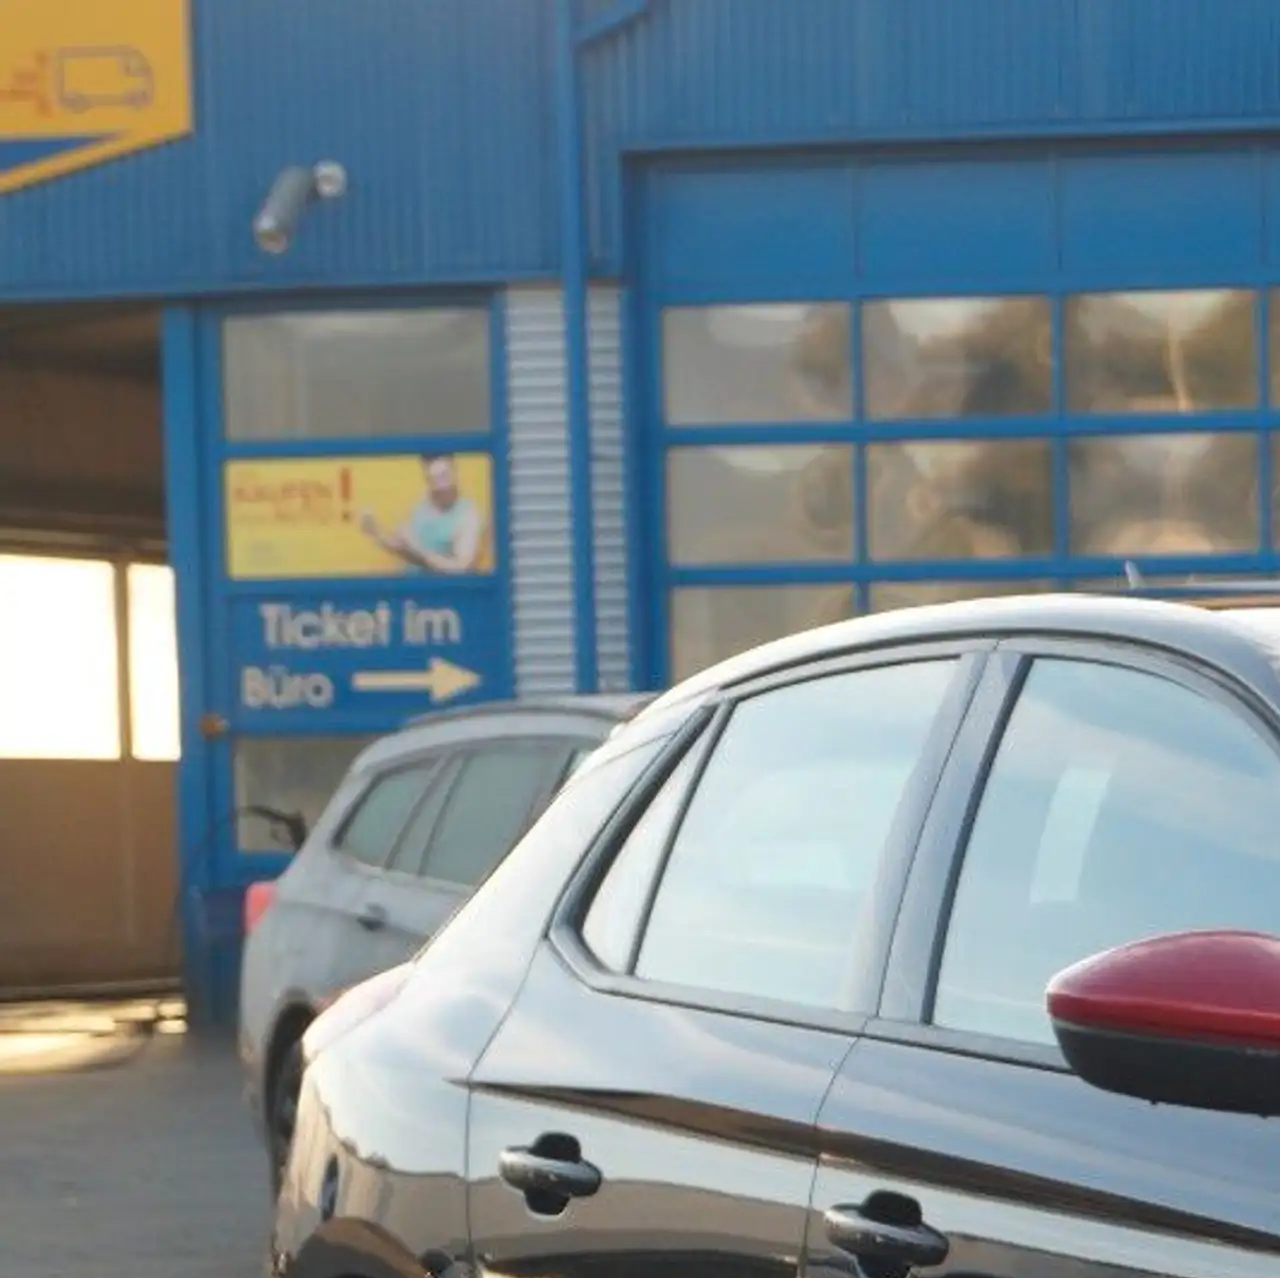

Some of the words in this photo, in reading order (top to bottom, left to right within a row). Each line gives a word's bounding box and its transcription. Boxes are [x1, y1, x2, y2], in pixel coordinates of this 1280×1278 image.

[260, 601, 391, 649] Ticket
[403, 600, 461, 645] im
[240, 664, 334, 709] Büro
